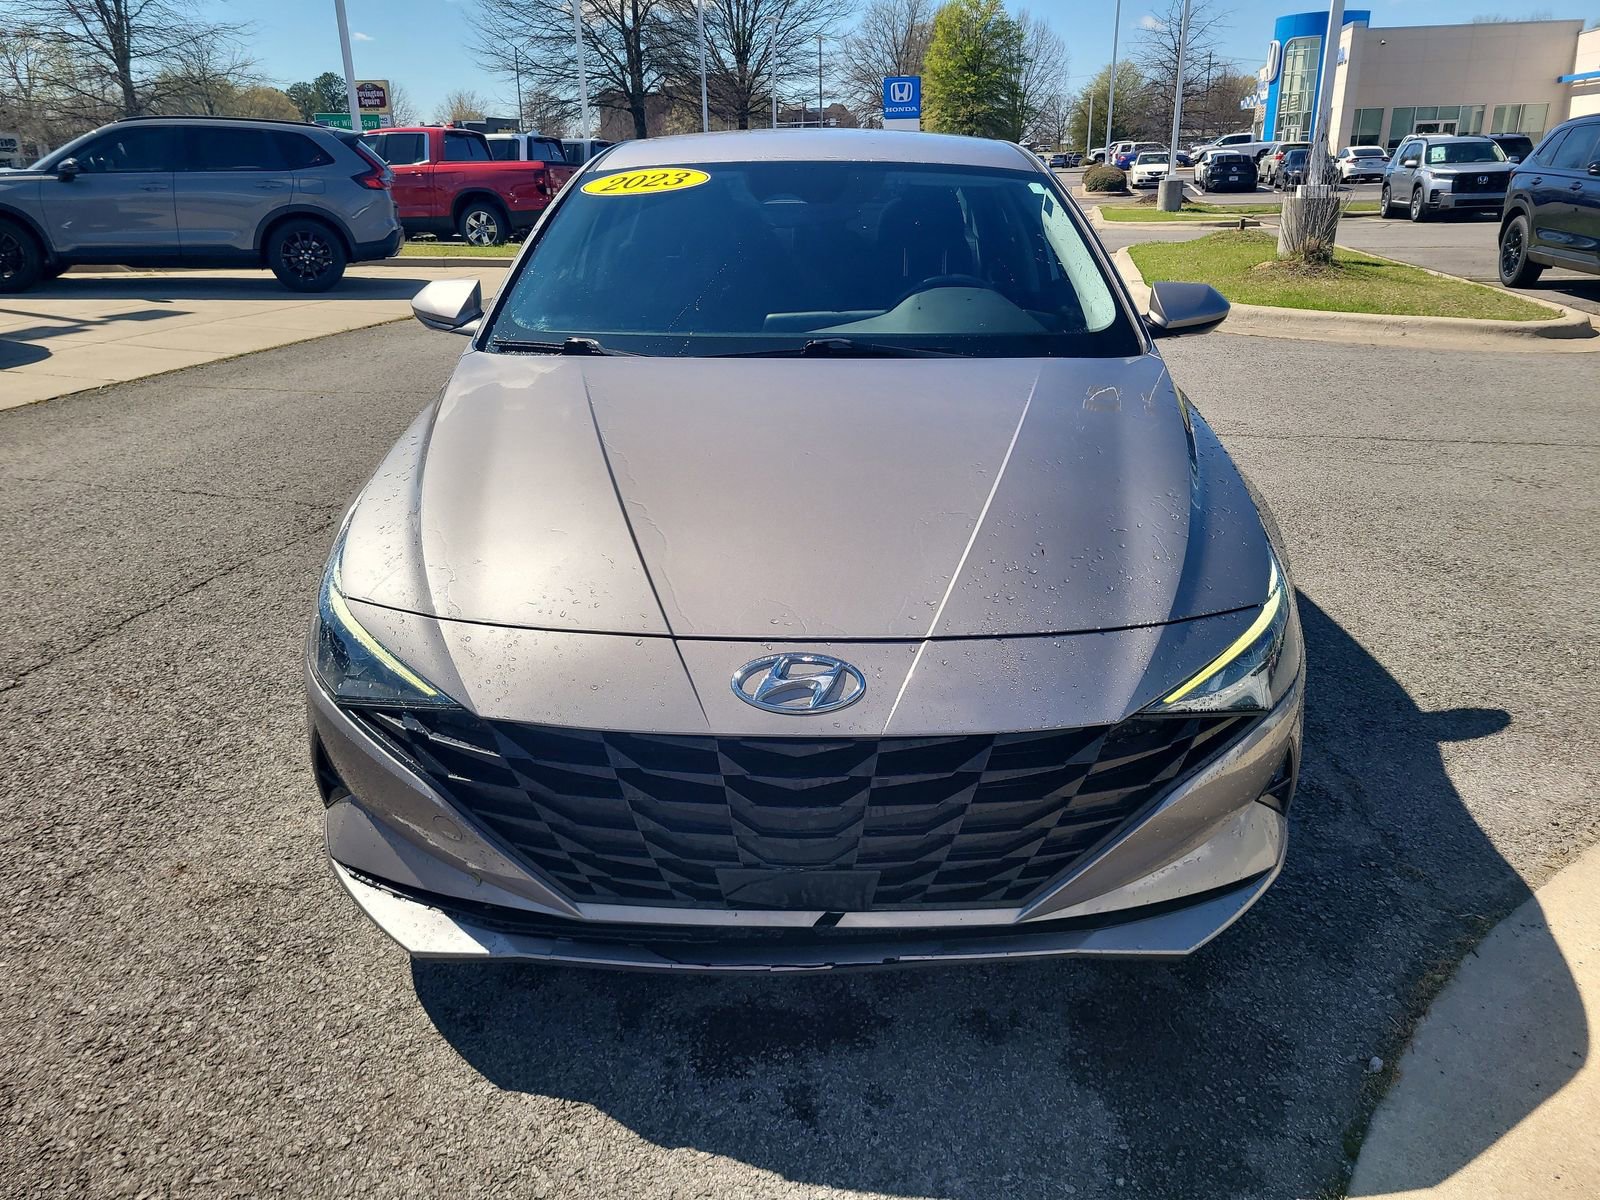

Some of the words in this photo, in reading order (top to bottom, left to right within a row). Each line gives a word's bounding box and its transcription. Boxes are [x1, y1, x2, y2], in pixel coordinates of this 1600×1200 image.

[358, 89, 384, 99] ovington
[361, 97, 381, 107] Square
[361, 119, 378, 129] cGary
[600, 172, 691, 192] 2023
